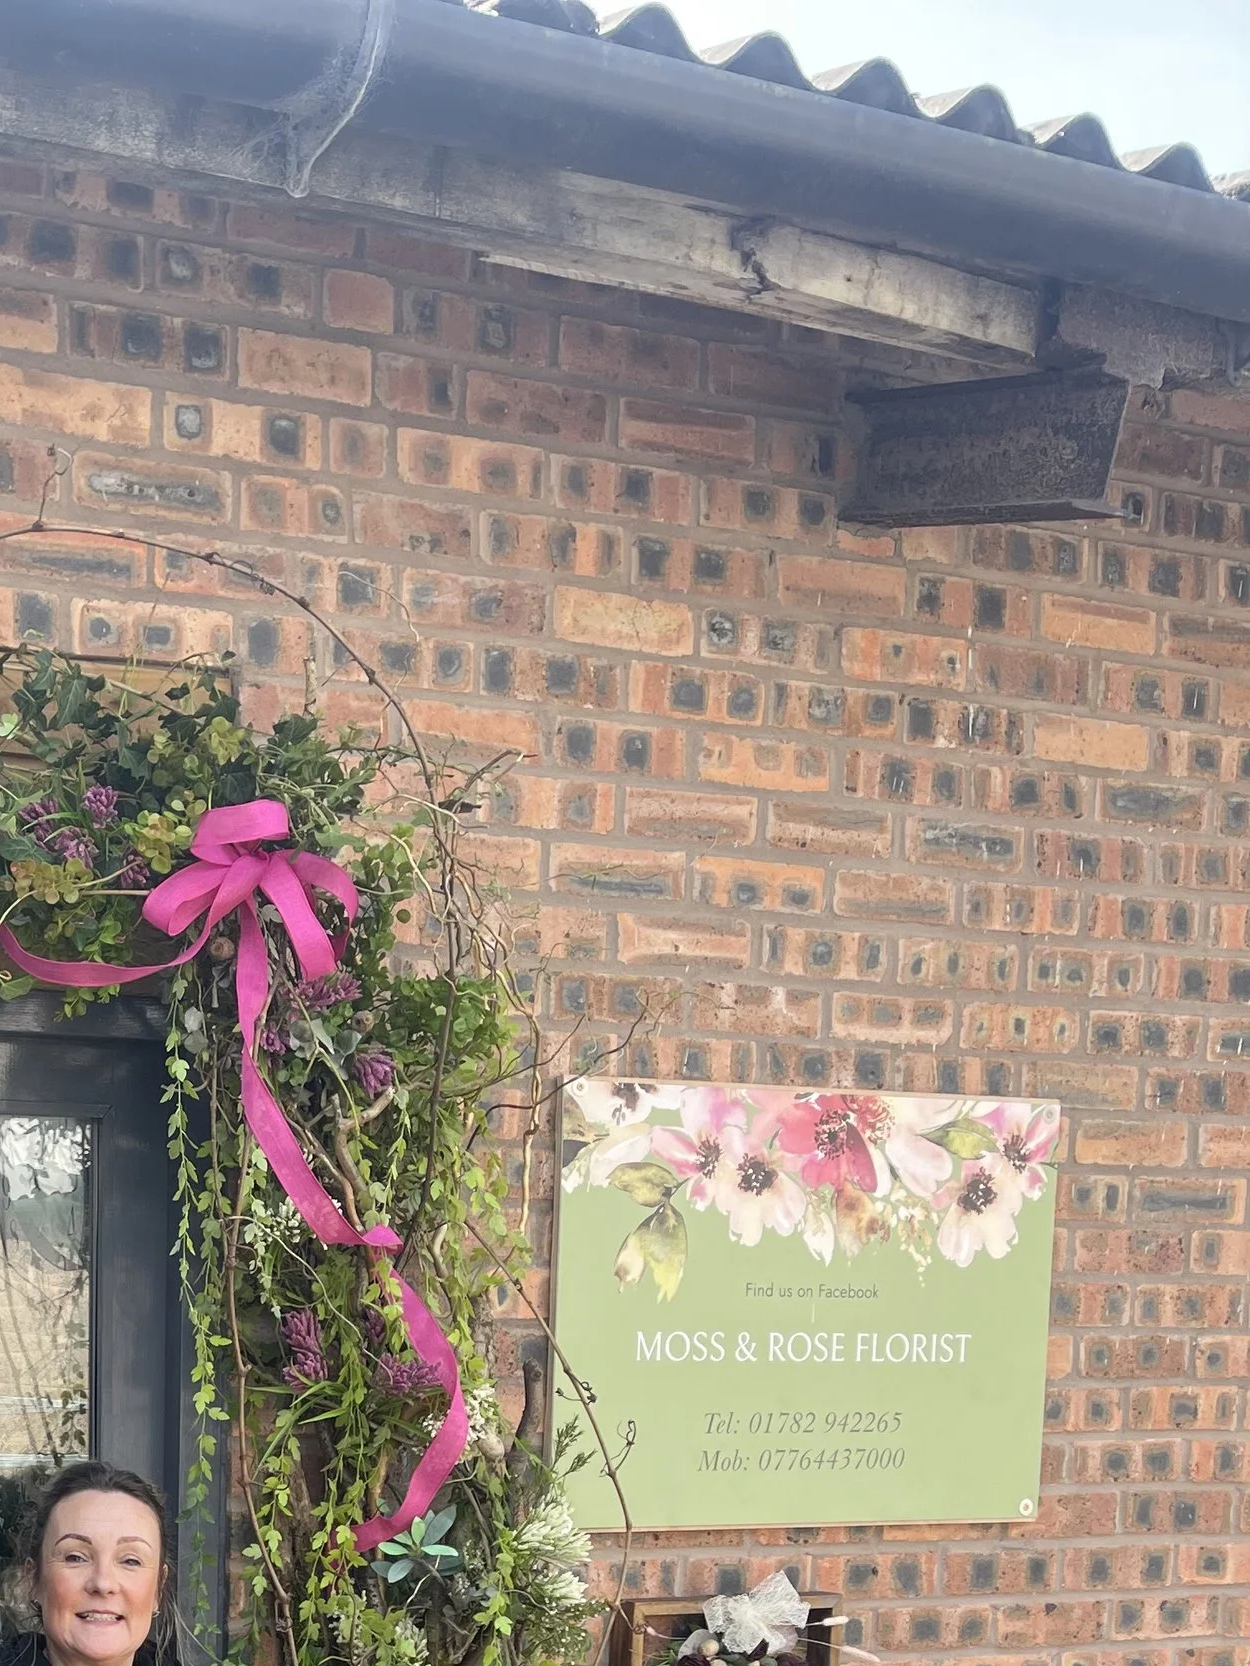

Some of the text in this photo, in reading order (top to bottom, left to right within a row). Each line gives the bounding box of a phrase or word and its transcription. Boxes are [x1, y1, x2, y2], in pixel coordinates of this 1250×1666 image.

[745, 1282, 879, 1300] Find us on Facebook
[635, 1331, 973, 1363] MOSS & ROSE FLORIST
[704, 1411, 903, 1435] Tel: 01782 942265
[697, 1447, 906, 1472] Mob: 07764437000
